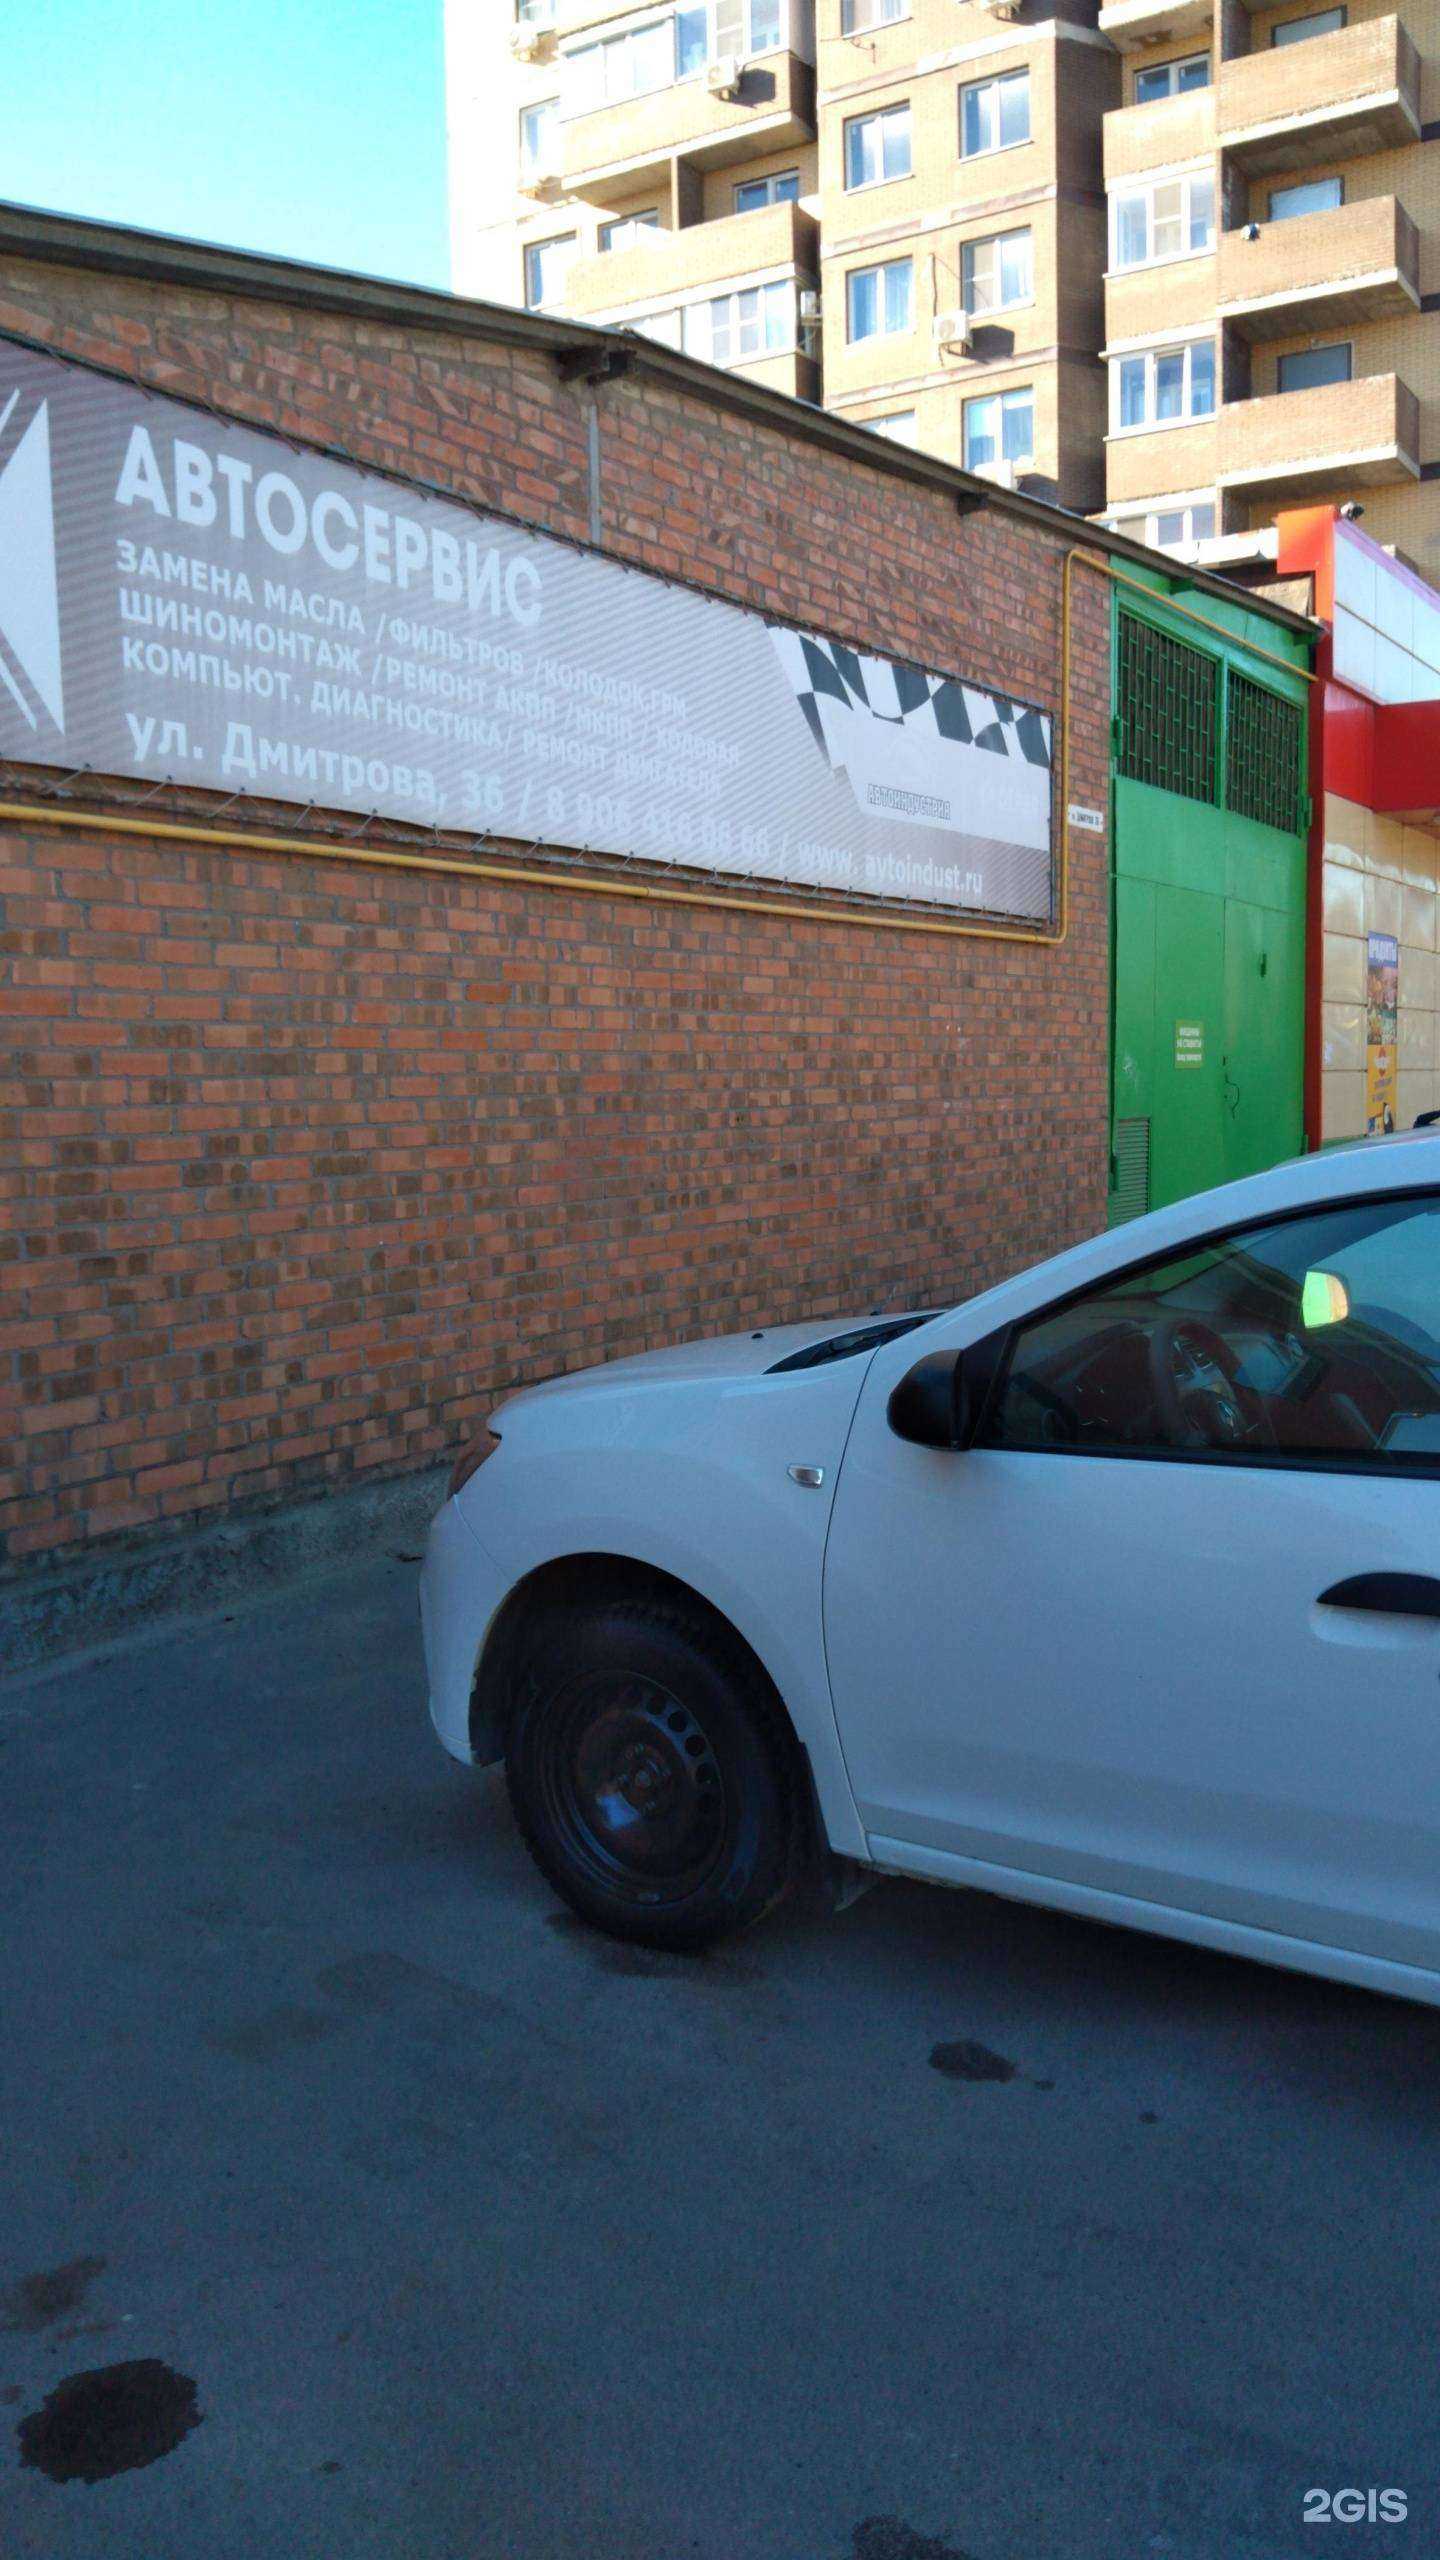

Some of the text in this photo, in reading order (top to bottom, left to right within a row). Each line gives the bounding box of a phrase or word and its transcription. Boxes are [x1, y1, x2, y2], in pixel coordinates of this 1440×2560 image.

[114, 424, 544, 626] АВТОСЕРВИС
[116, 538, 254, 605] ЗАМЕНА
[263, 578, 367, 636] МАСЛА
[119, 587, 363, 677] ШИНОМОНТАЖ
[122, 636, 302, 705] КОМПЬЮТ.
[522, 728, 606, 772] РЕМОНТ
[125, 712, 204, 763] ул.
[220, 720, 448, 812] Дмитрова,
[461, 768, 504, 814] 36
[865, 782, 952, 823] АВТОИНДУСТРИЯ
